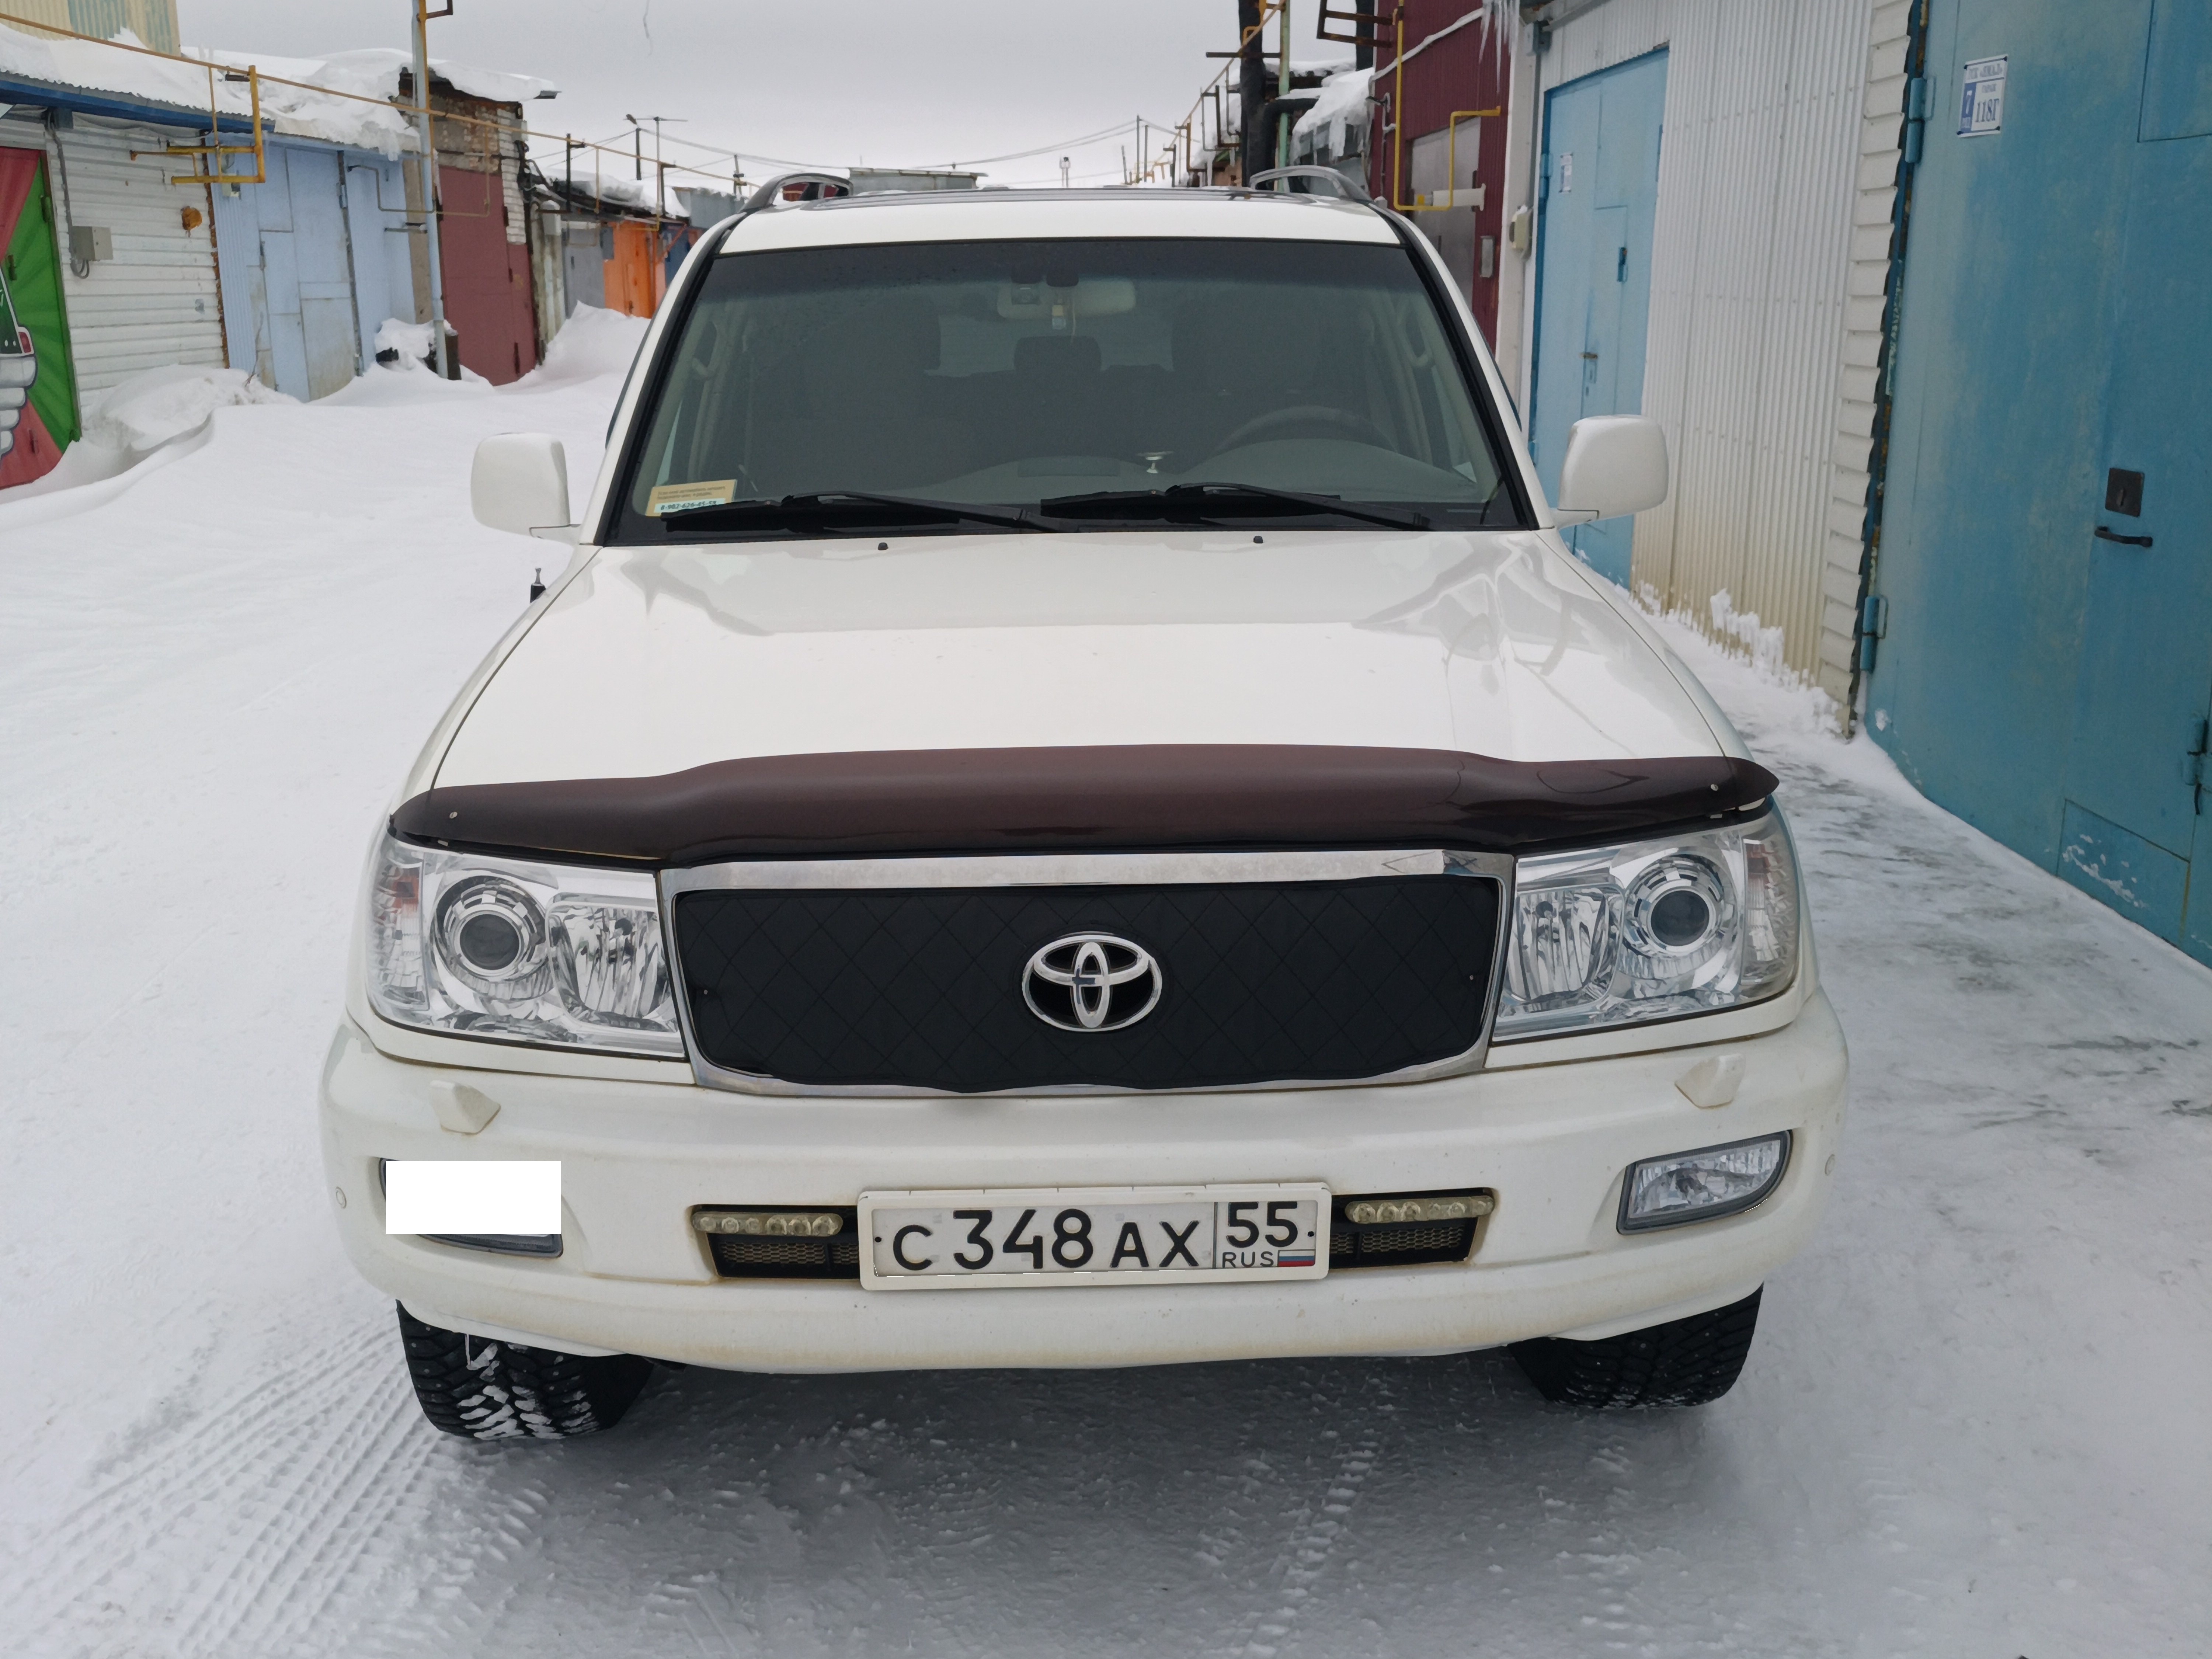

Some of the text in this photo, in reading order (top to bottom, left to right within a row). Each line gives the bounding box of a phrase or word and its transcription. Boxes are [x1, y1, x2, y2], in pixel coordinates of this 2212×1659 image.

[953, 1208, 1094, 1270] 348
[1226, 1201, 1298, 1248] 55
[1222, 1251, 1274, 1269] RUS
